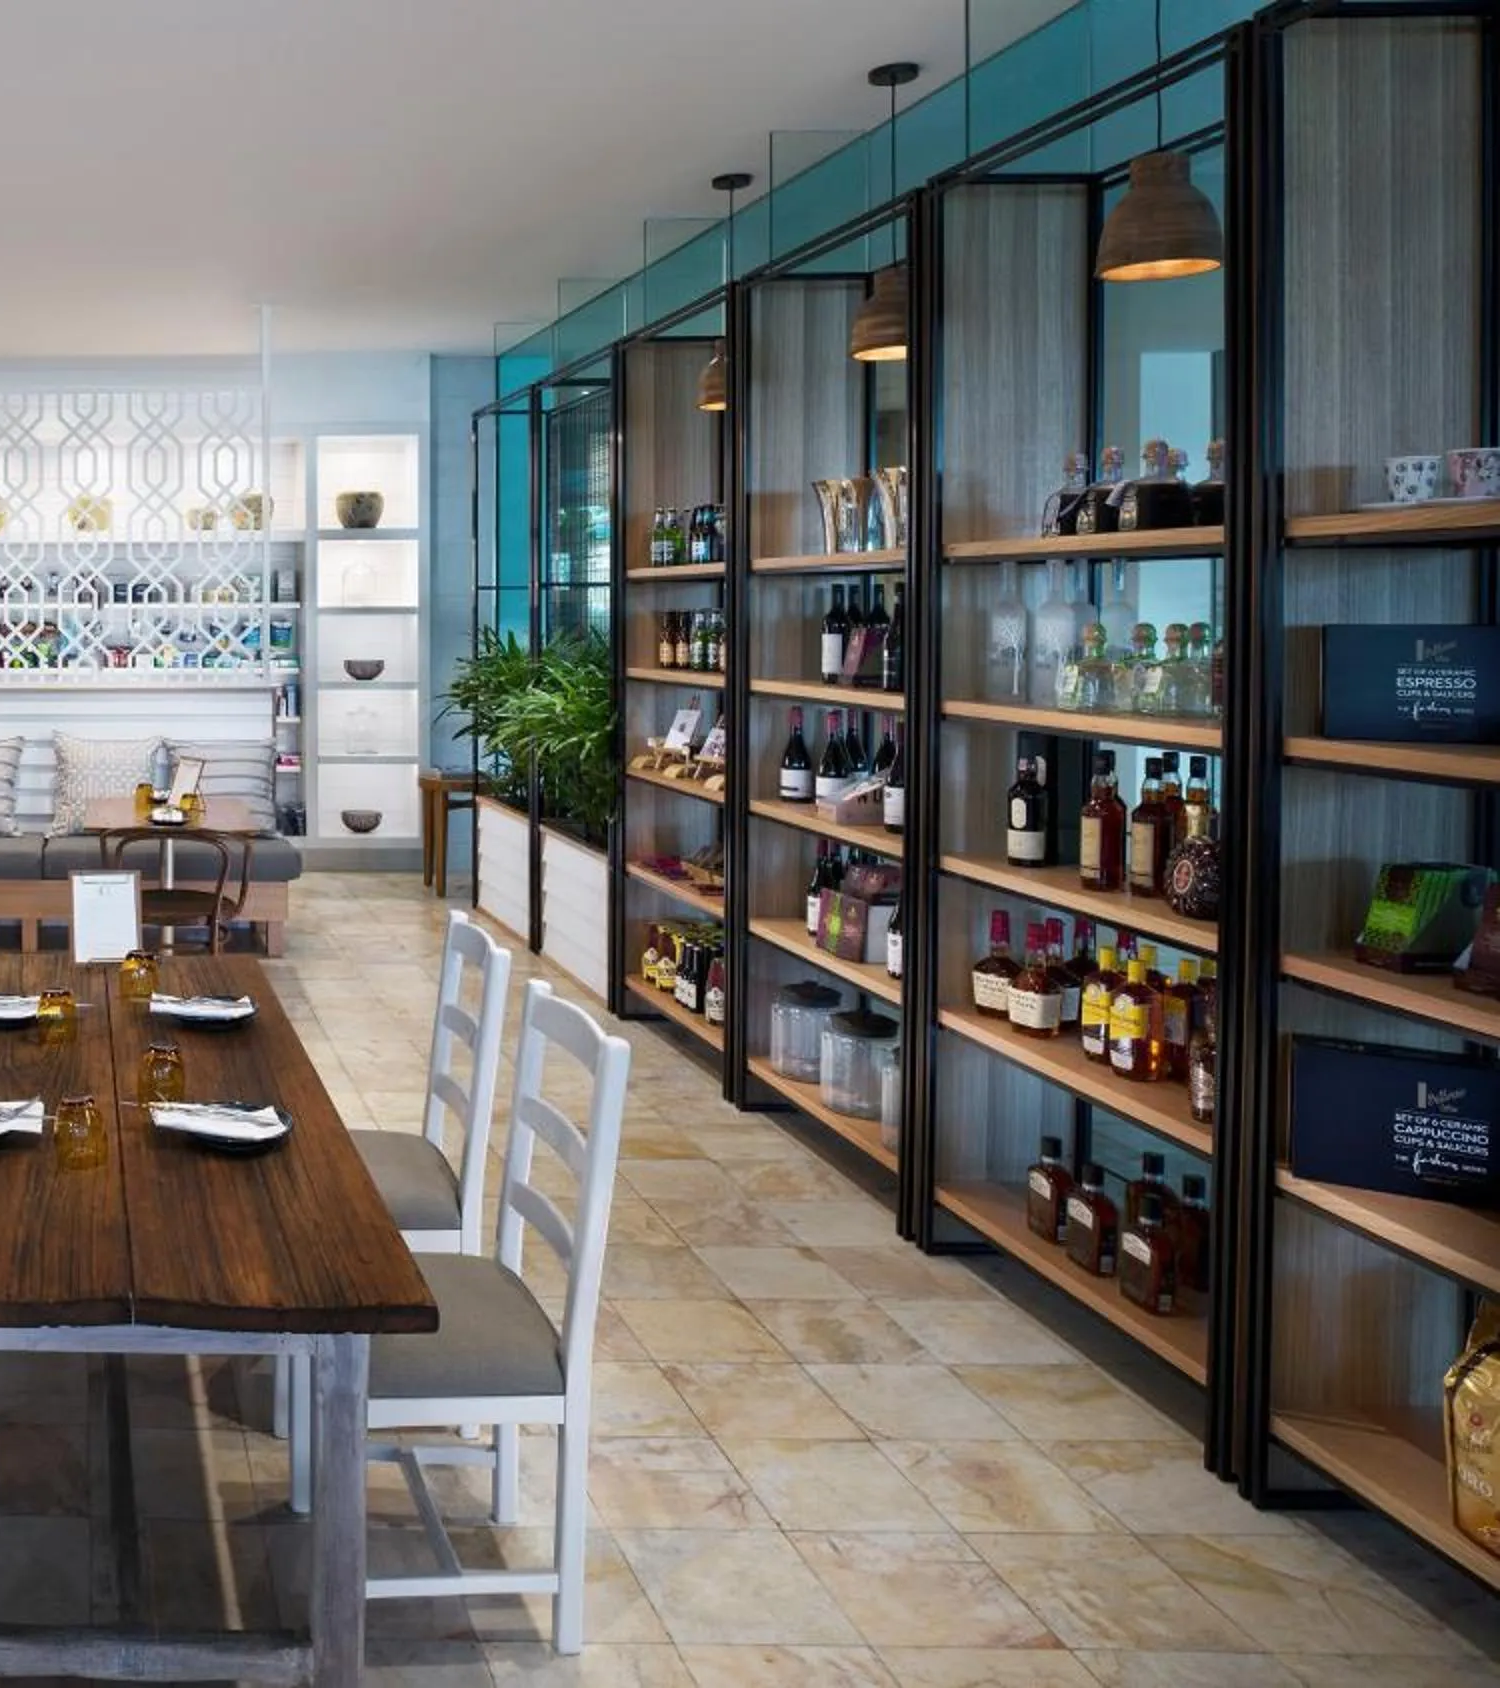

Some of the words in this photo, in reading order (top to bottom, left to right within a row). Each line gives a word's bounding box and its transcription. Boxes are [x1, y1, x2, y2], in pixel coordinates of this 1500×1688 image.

[1396, 677, 1477, 689] ESPRESSO
[1393, 1123, 1489, 1145] CAPPUCCINO
[1395, 1113, 1413, 1123] SET
[1415, 1116, 1430, 1125] OF
[1431, 1119, 1439, 1127] 6
[1440, 1120, 1489, 1134] CERAMIC
[1393, 1134, 1424, 1147] CUPS
[1426, 1140, 1434, 1149] &
[1436, 1141, 1489, 1157] SAUCERS
